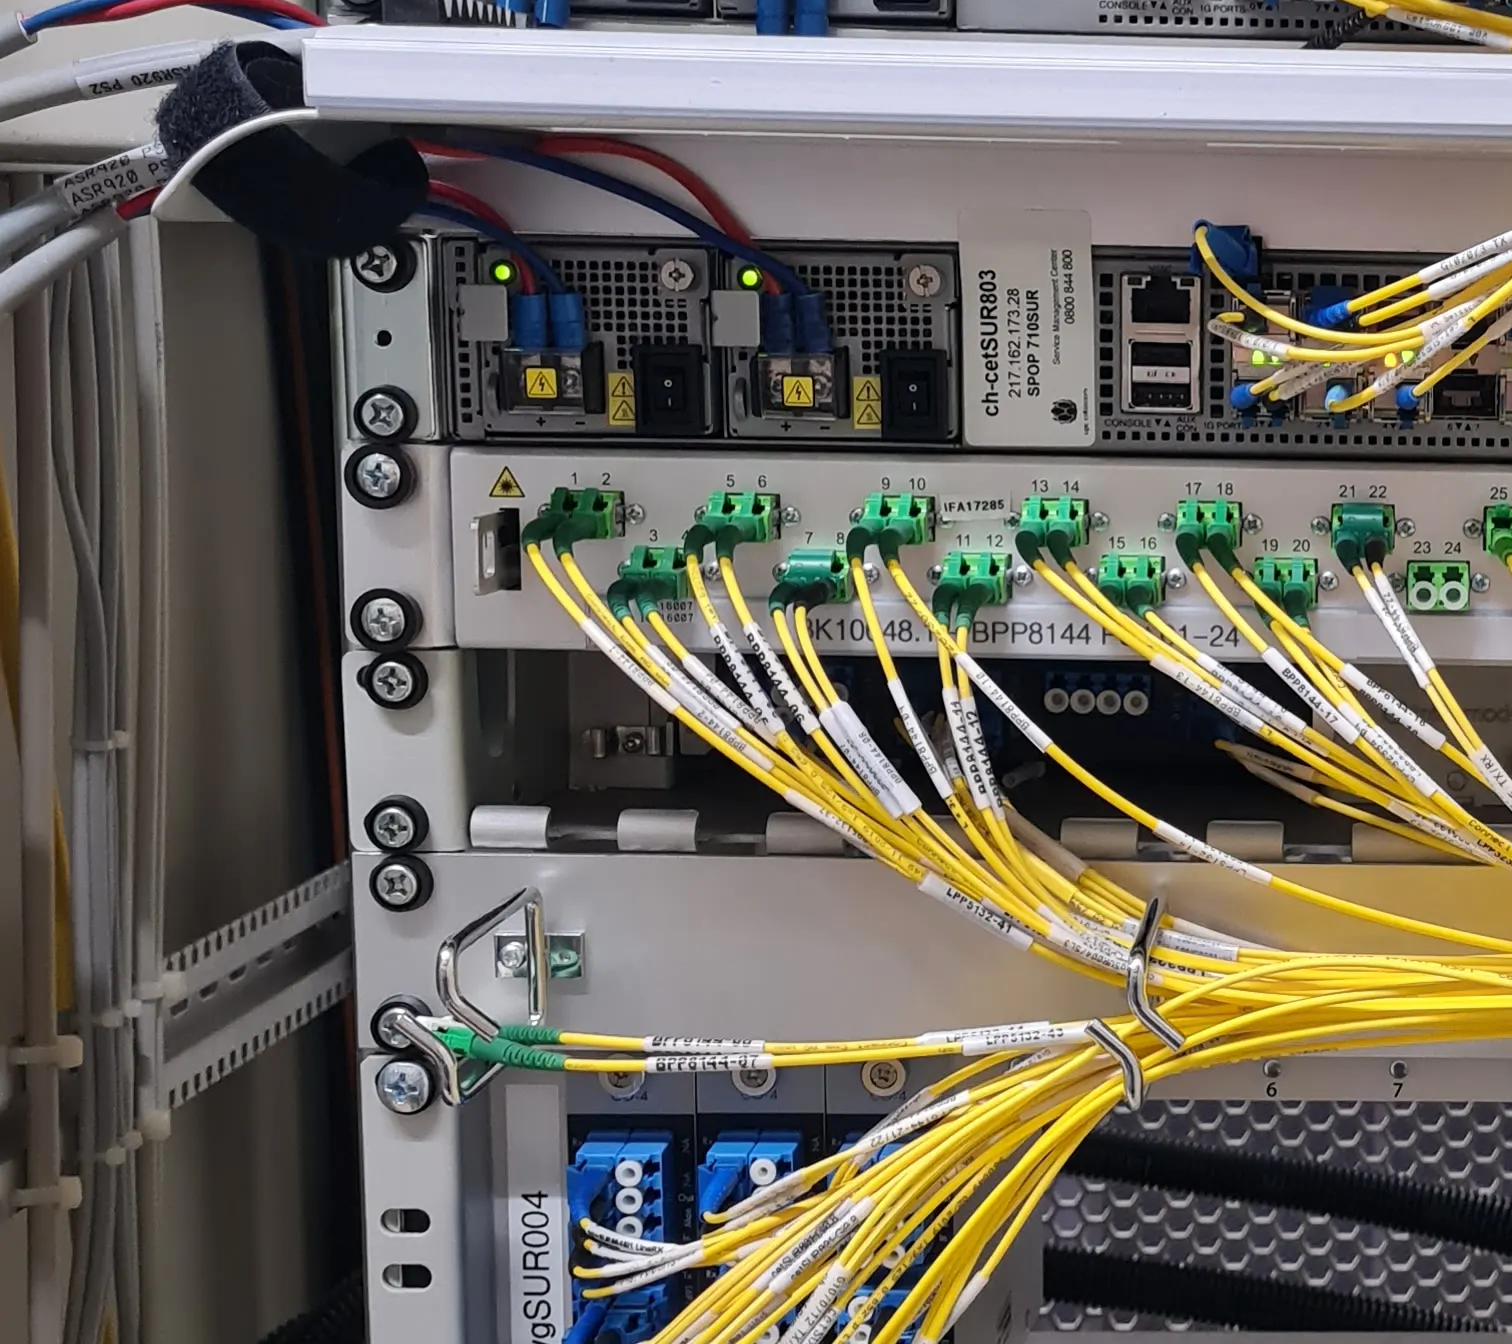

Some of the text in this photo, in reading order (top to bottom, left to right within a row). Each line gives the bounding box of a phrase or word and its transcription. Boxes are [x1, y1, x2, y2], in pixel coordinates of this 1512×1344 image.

[1099, 0, 1148, 10] CONSOLE
[1172, 7, 1194, 16] CON
[1213, 5, 1247, 14] PORTS
[88, 63, 200, 96] ASR920 PS2
[64, 155, 130, 189] ASR920
[71, 171, 139, 206] ASR920
[1064, 249, 1075, 325] 0800 844 800
[1051, 249, 1062, 365] Service Management Center
[978, 269, 999, 417] ch-cetSUR803
[1007, 287, 1022, 399] 217.162.173.28
[1027, 289, 1040, 398] SPOP 710SUR
[1104, 418, 1152, 428] CONSOLE
[602, 473, 610, 485] 2
[727, 475, 766, 488] 5 6
[882, 477, 925, 490] 9 10
[1032, 480, 1079, 492] 13 14
[1186, 482, 1233, 495] 17 18
[1340, 485, 1387, 498] 21 22
[1490, 487, 1507, 500] 25
[944, 499, 1004, 512] IFA17285
[972, 623, 1092, 646] BPP8144
[1279, 665, 1340, 726] BPP8144-17
[1477, 752, 1510, 788] TX/RX
[944, 884, 1014, 936] LPP5132-41
[1267, 1082, 1277, 1097] 6
[1394, 1083, 1403, 1097] 7
